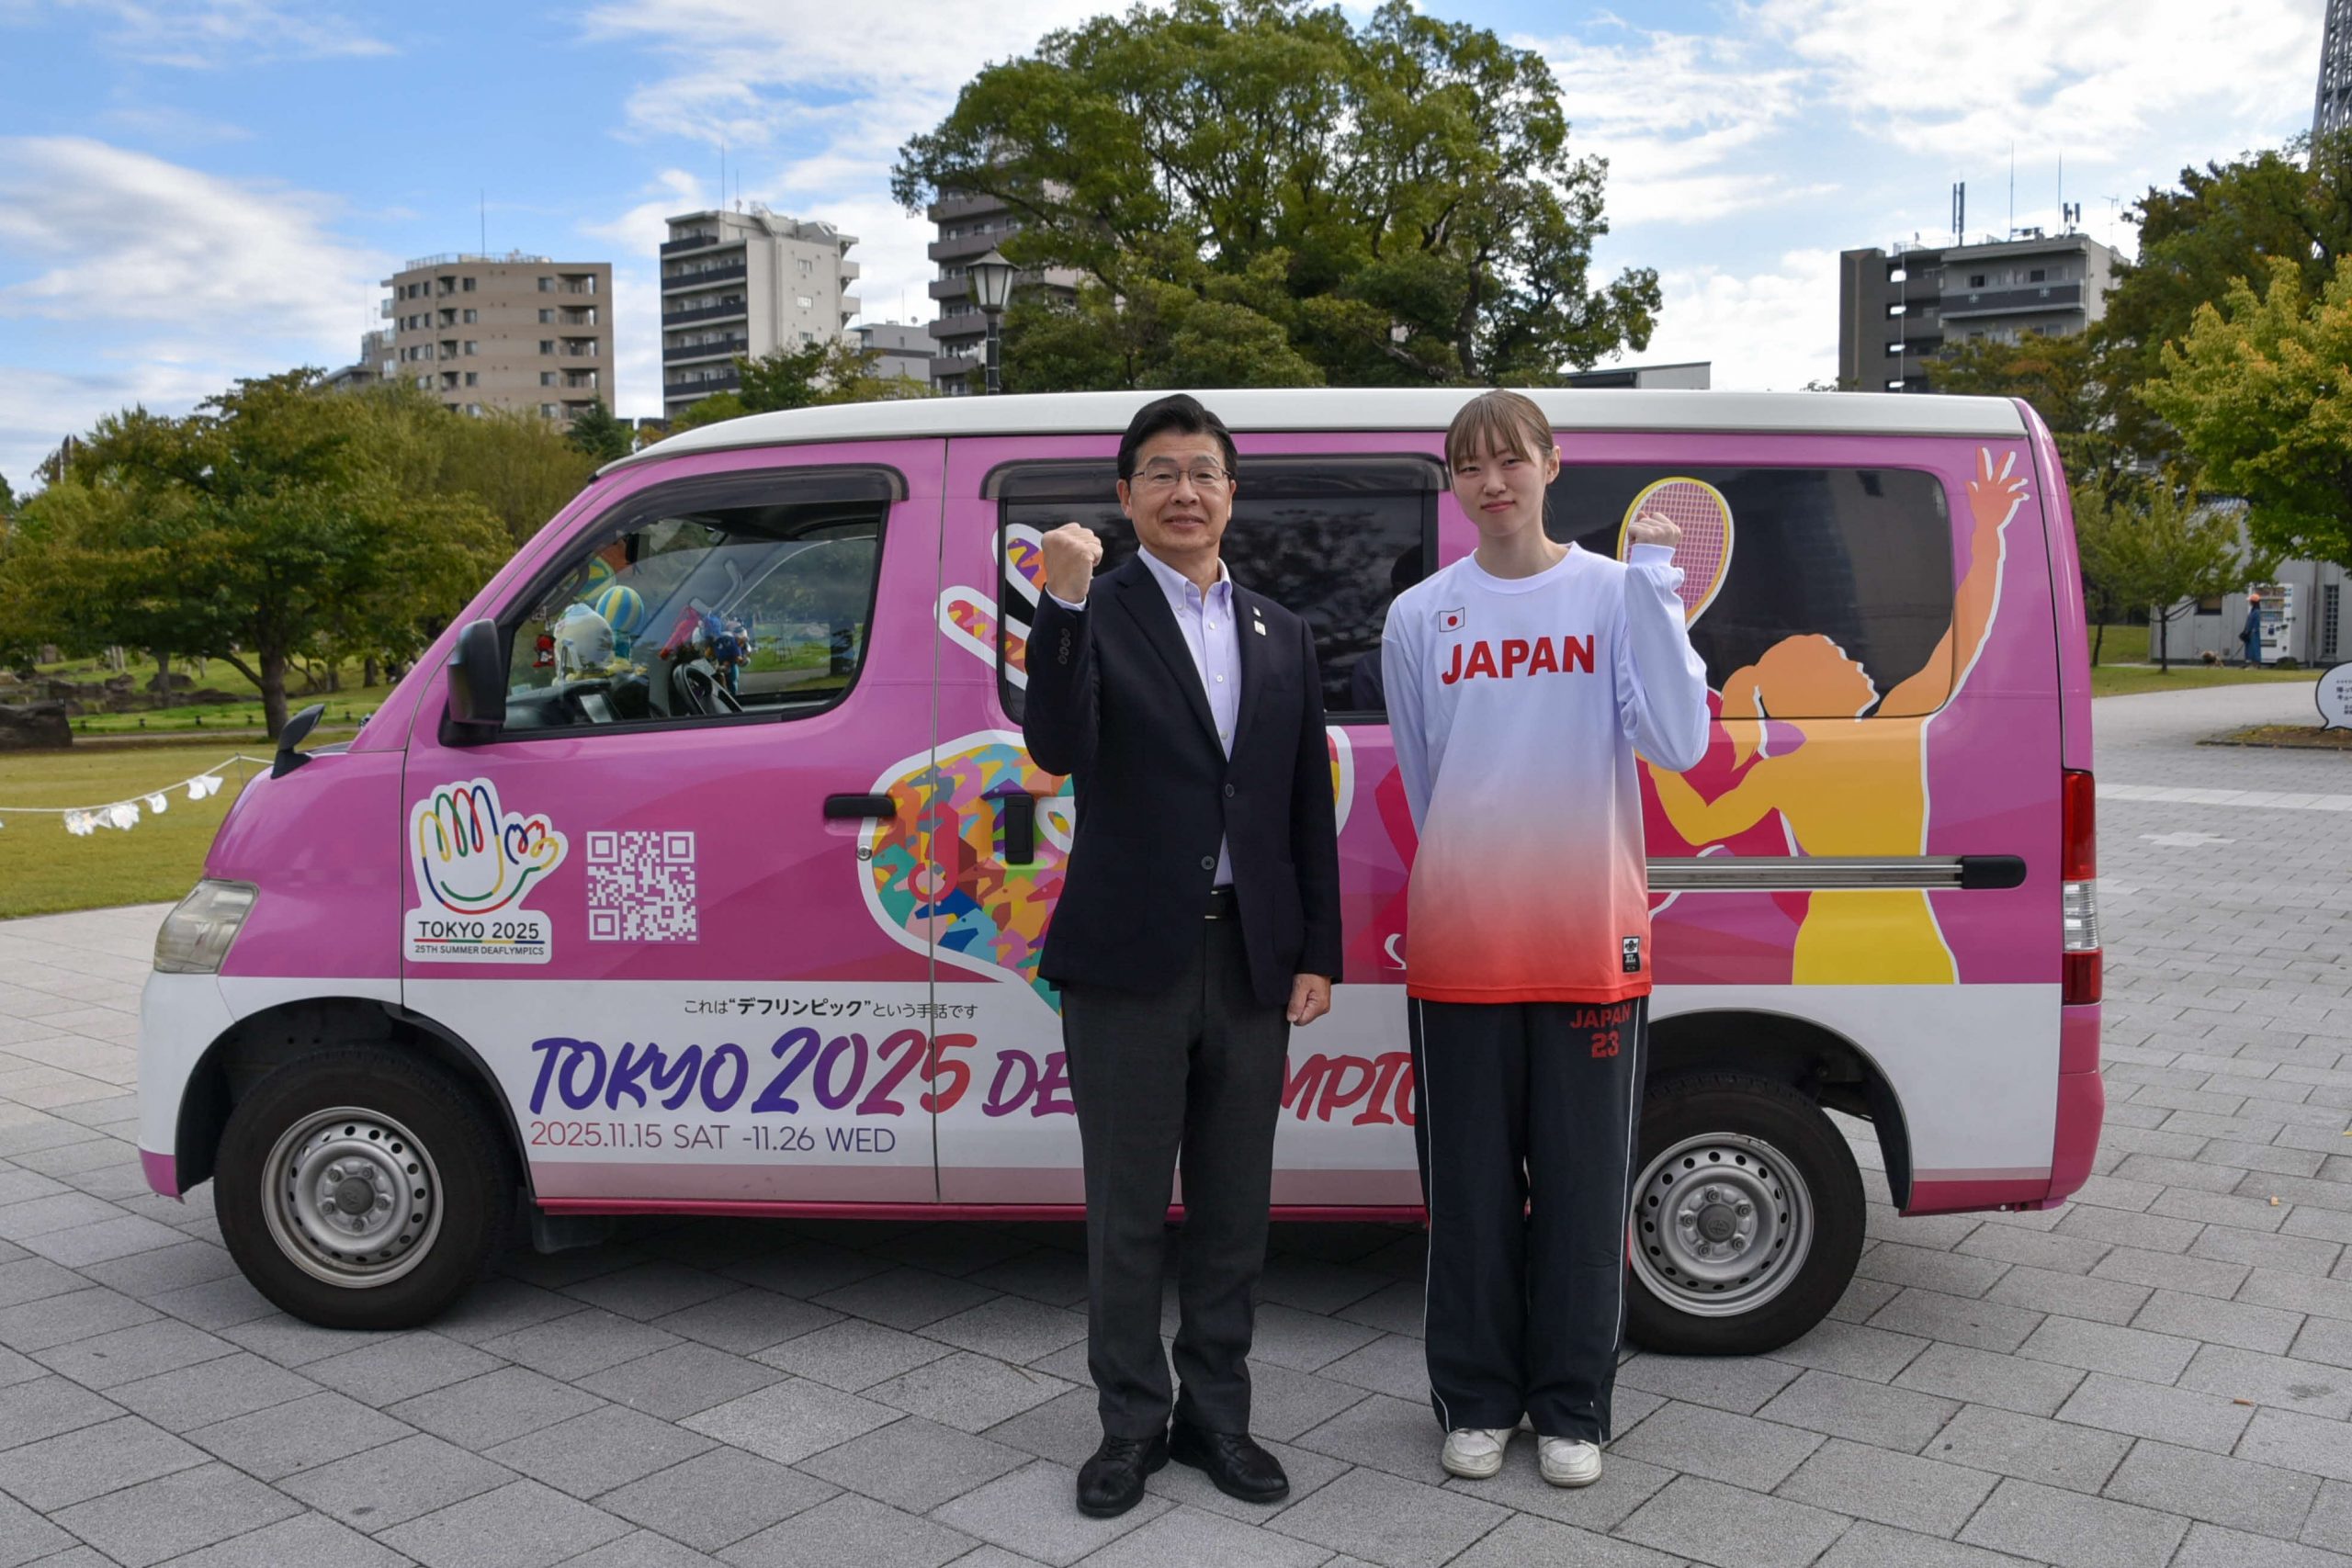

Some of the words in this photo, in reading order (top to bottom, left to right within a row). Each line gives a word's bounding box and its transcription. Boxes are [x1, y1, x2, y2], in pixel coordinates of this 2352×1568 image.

[1442, 635, 1595, 685] JAPAN
[418, 921, 485, 938] TOKYO
[492, 922, 539, 940] 2025
[415, 945, 438, 953] 25TH
[440, 945, 479, 954] SUMMER
[481, 946, 544, 955] DEAFLYMPICS
[1570, 1004, 1632, 1029] JAPAN
[1591, 1031, 1621, 1058] 23
[529, 1037, 749, 1115] TOKYO
[751, 1027, 978, 1117] 2025
[530, 1121, 662, 1148] 2025.11.15
[673, 1123, 730, 1149] SAT
[825, 1127, 897, 1153] WED
